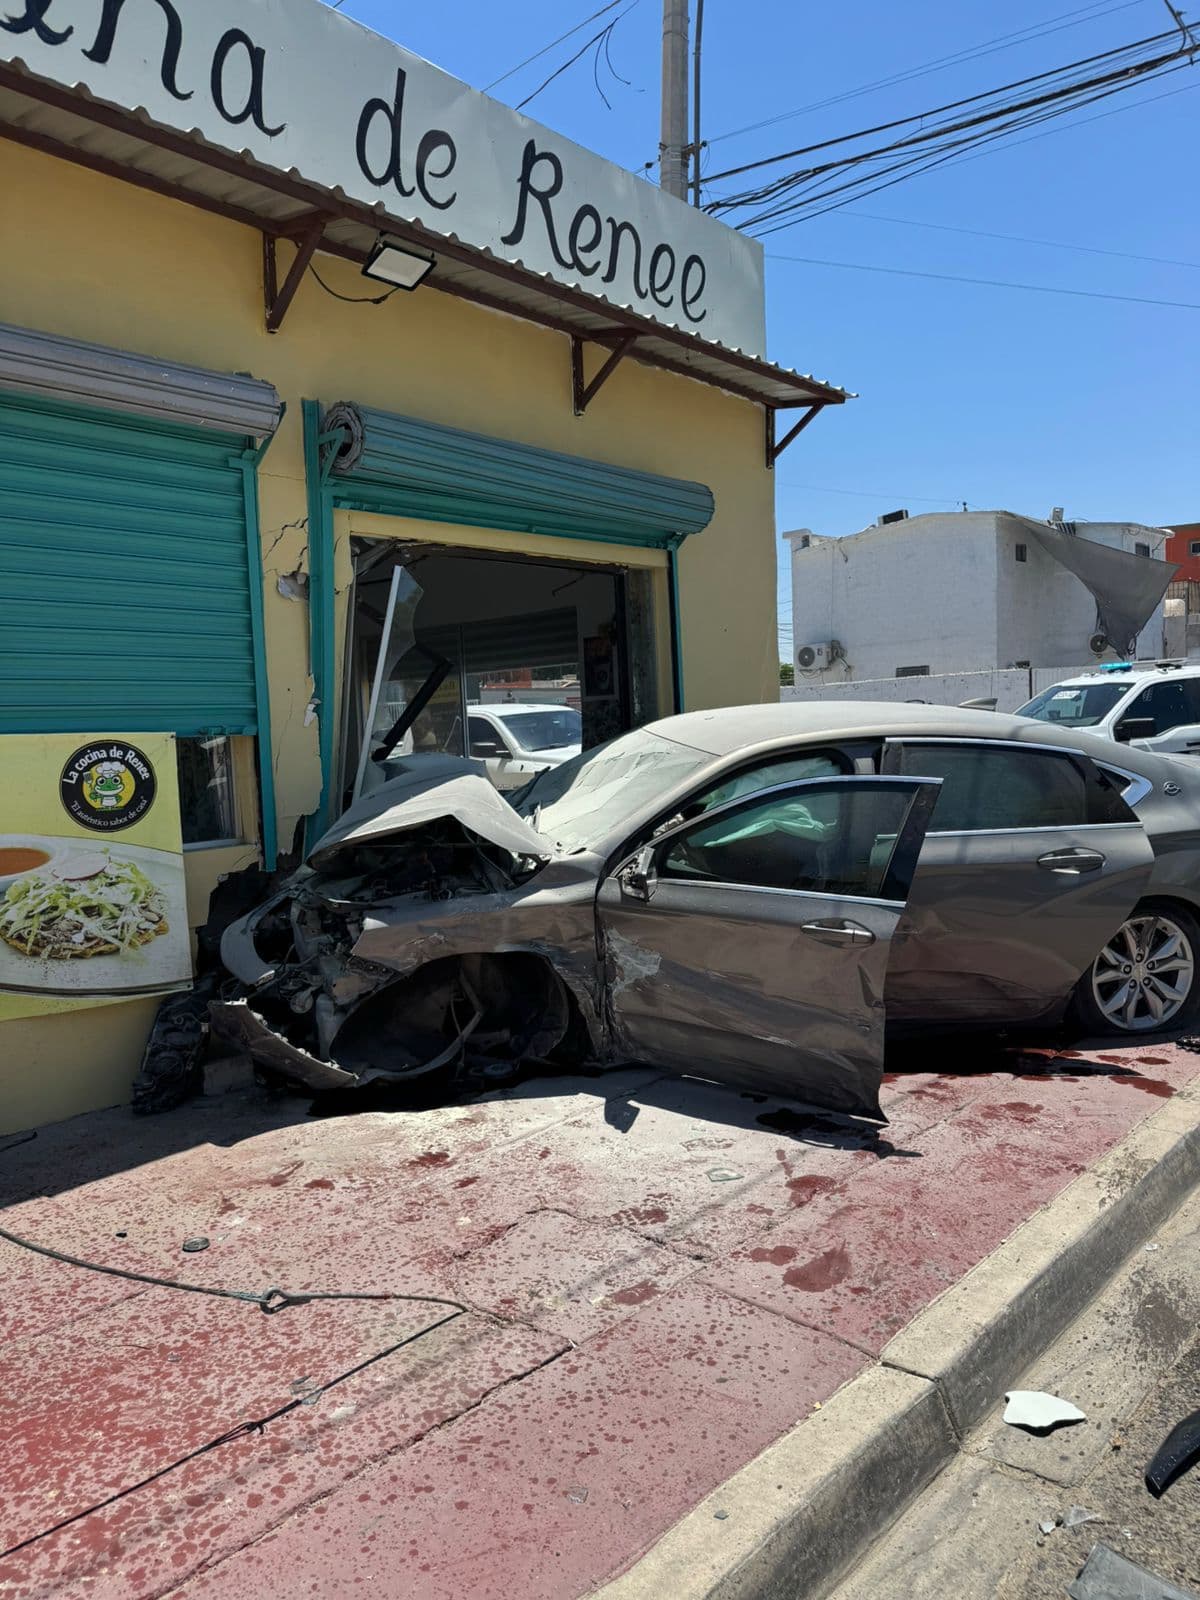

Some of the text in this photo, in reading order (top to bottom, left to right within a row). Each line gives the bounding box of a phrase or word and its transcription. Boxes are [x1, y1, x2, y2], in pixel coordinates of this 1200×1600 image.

[355, 68, 457, 210] de
[501, 138, 707, 323] Renee
[62, 745, 151, 784] La cocina de Renee
